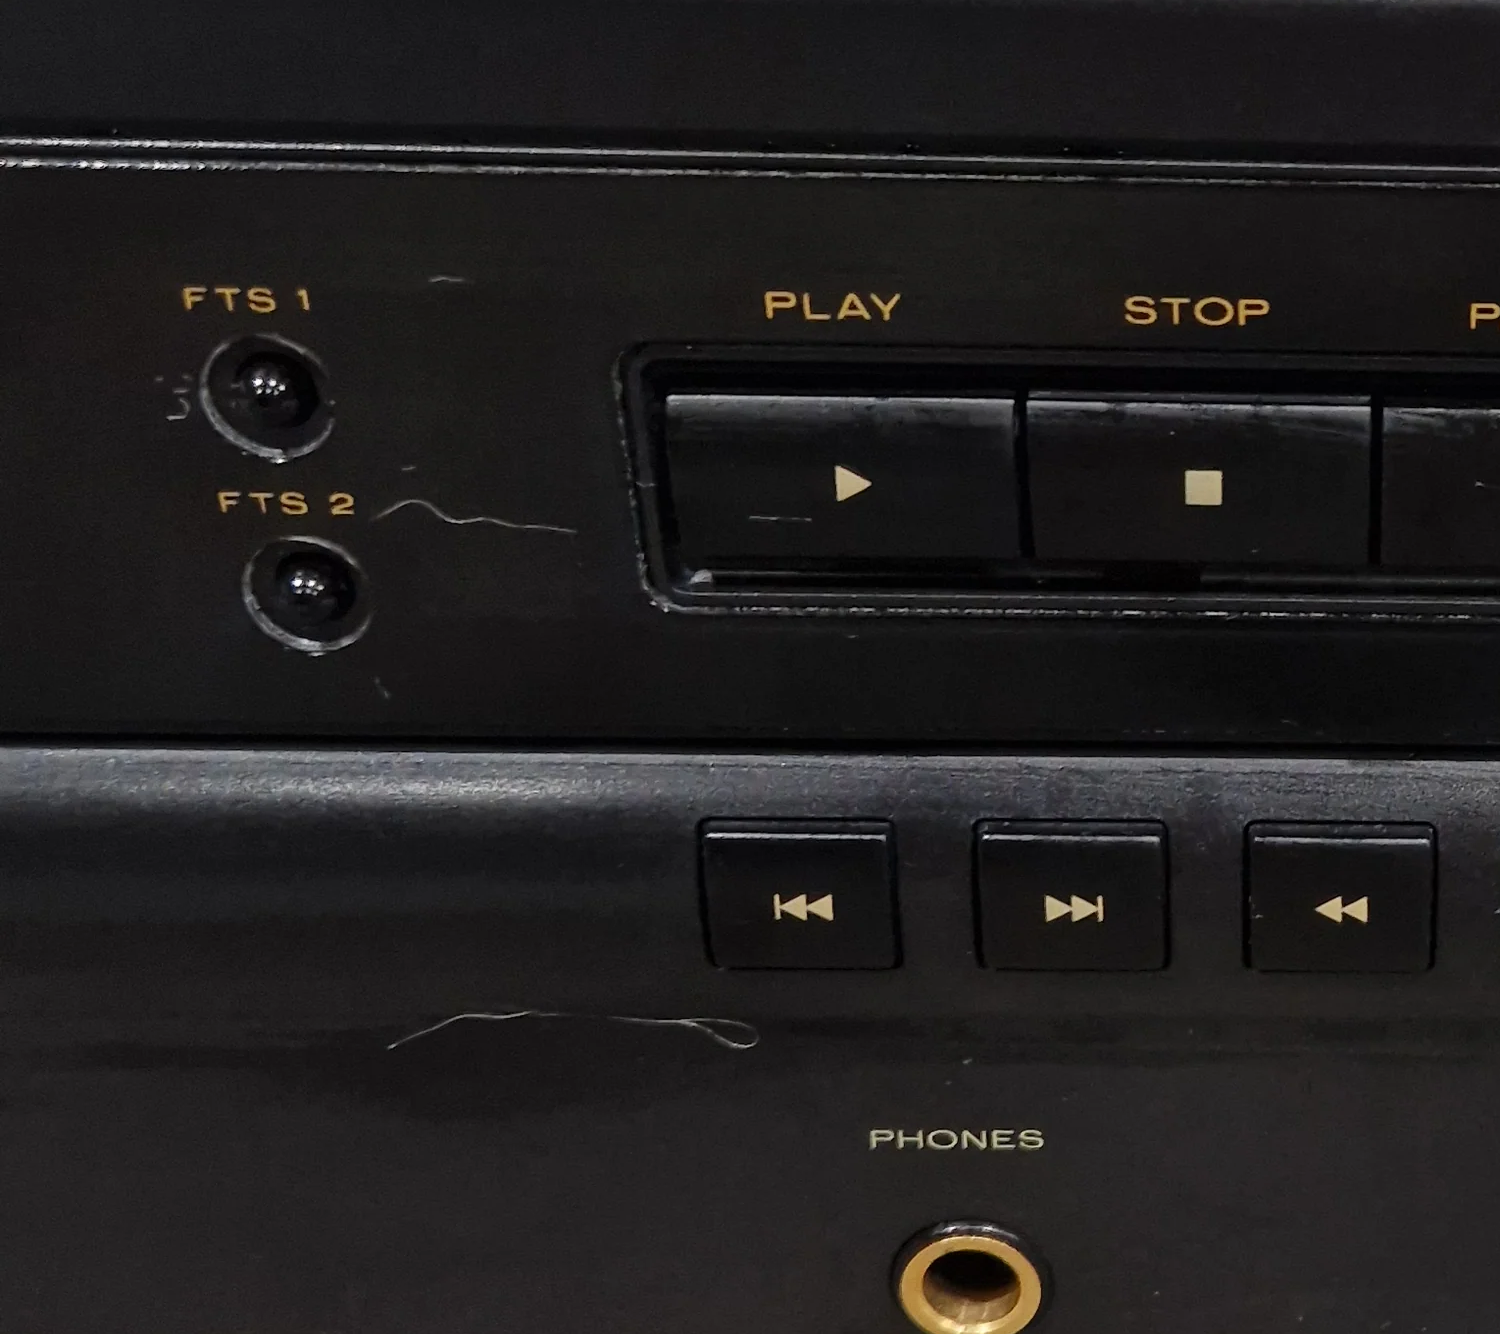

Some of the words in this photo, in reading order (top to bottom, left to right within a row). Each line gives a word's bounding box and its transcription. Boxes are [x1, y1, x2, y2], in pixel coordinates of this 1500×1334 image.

[182, 286, 277, 313] FTS
[297, 288, 311, 312] 1
[763, 290, 902, 322] PLAY
[1123, 295, 1271, 327] STOP
[216, 490, 309, 516] FTS
[328, 492, 356, 517] 2
[868, 1128, 1046, 1151] PHONES
